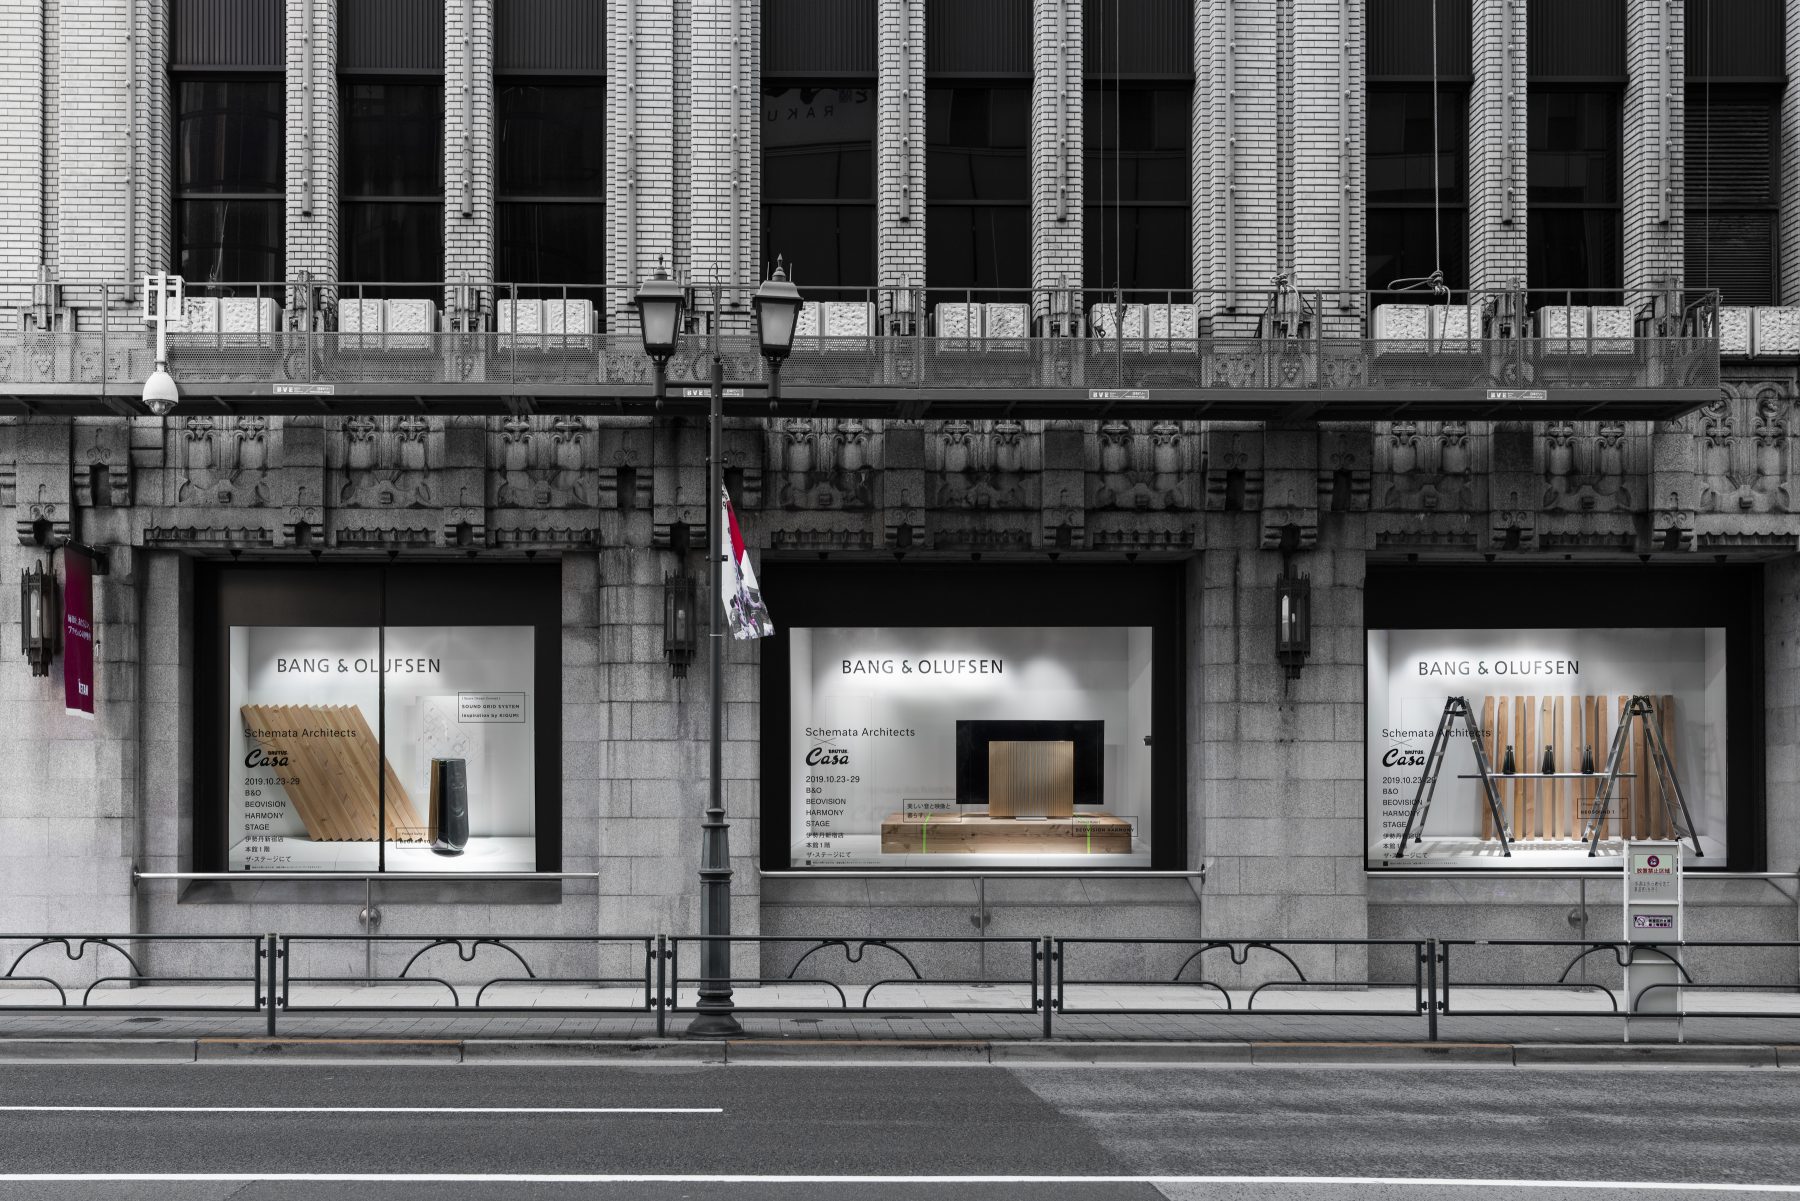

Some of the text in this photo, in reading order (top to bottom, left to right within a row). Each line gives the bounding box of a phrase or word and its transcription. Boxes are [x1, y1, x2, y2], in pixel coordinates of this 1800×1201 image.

[277, 658, 441, 673] BANG & OLUFSEN
[842, 659, 1004, 674] BANG & OLUFSEN
[1418, 660, 1580, 675] BANG & OLUFSEN
[244, 728, 357, 738] Schemata Architects
[805, 727, 916, 737] Schemata Architects
[1382, 728, 1434, 738] Schemata
[244, 748, 289, 769] Casa
[805, 747, 850, 767] Casa
[1382, 748, 1426, 768] Casa
[244, 789, 262, 797] B&O
